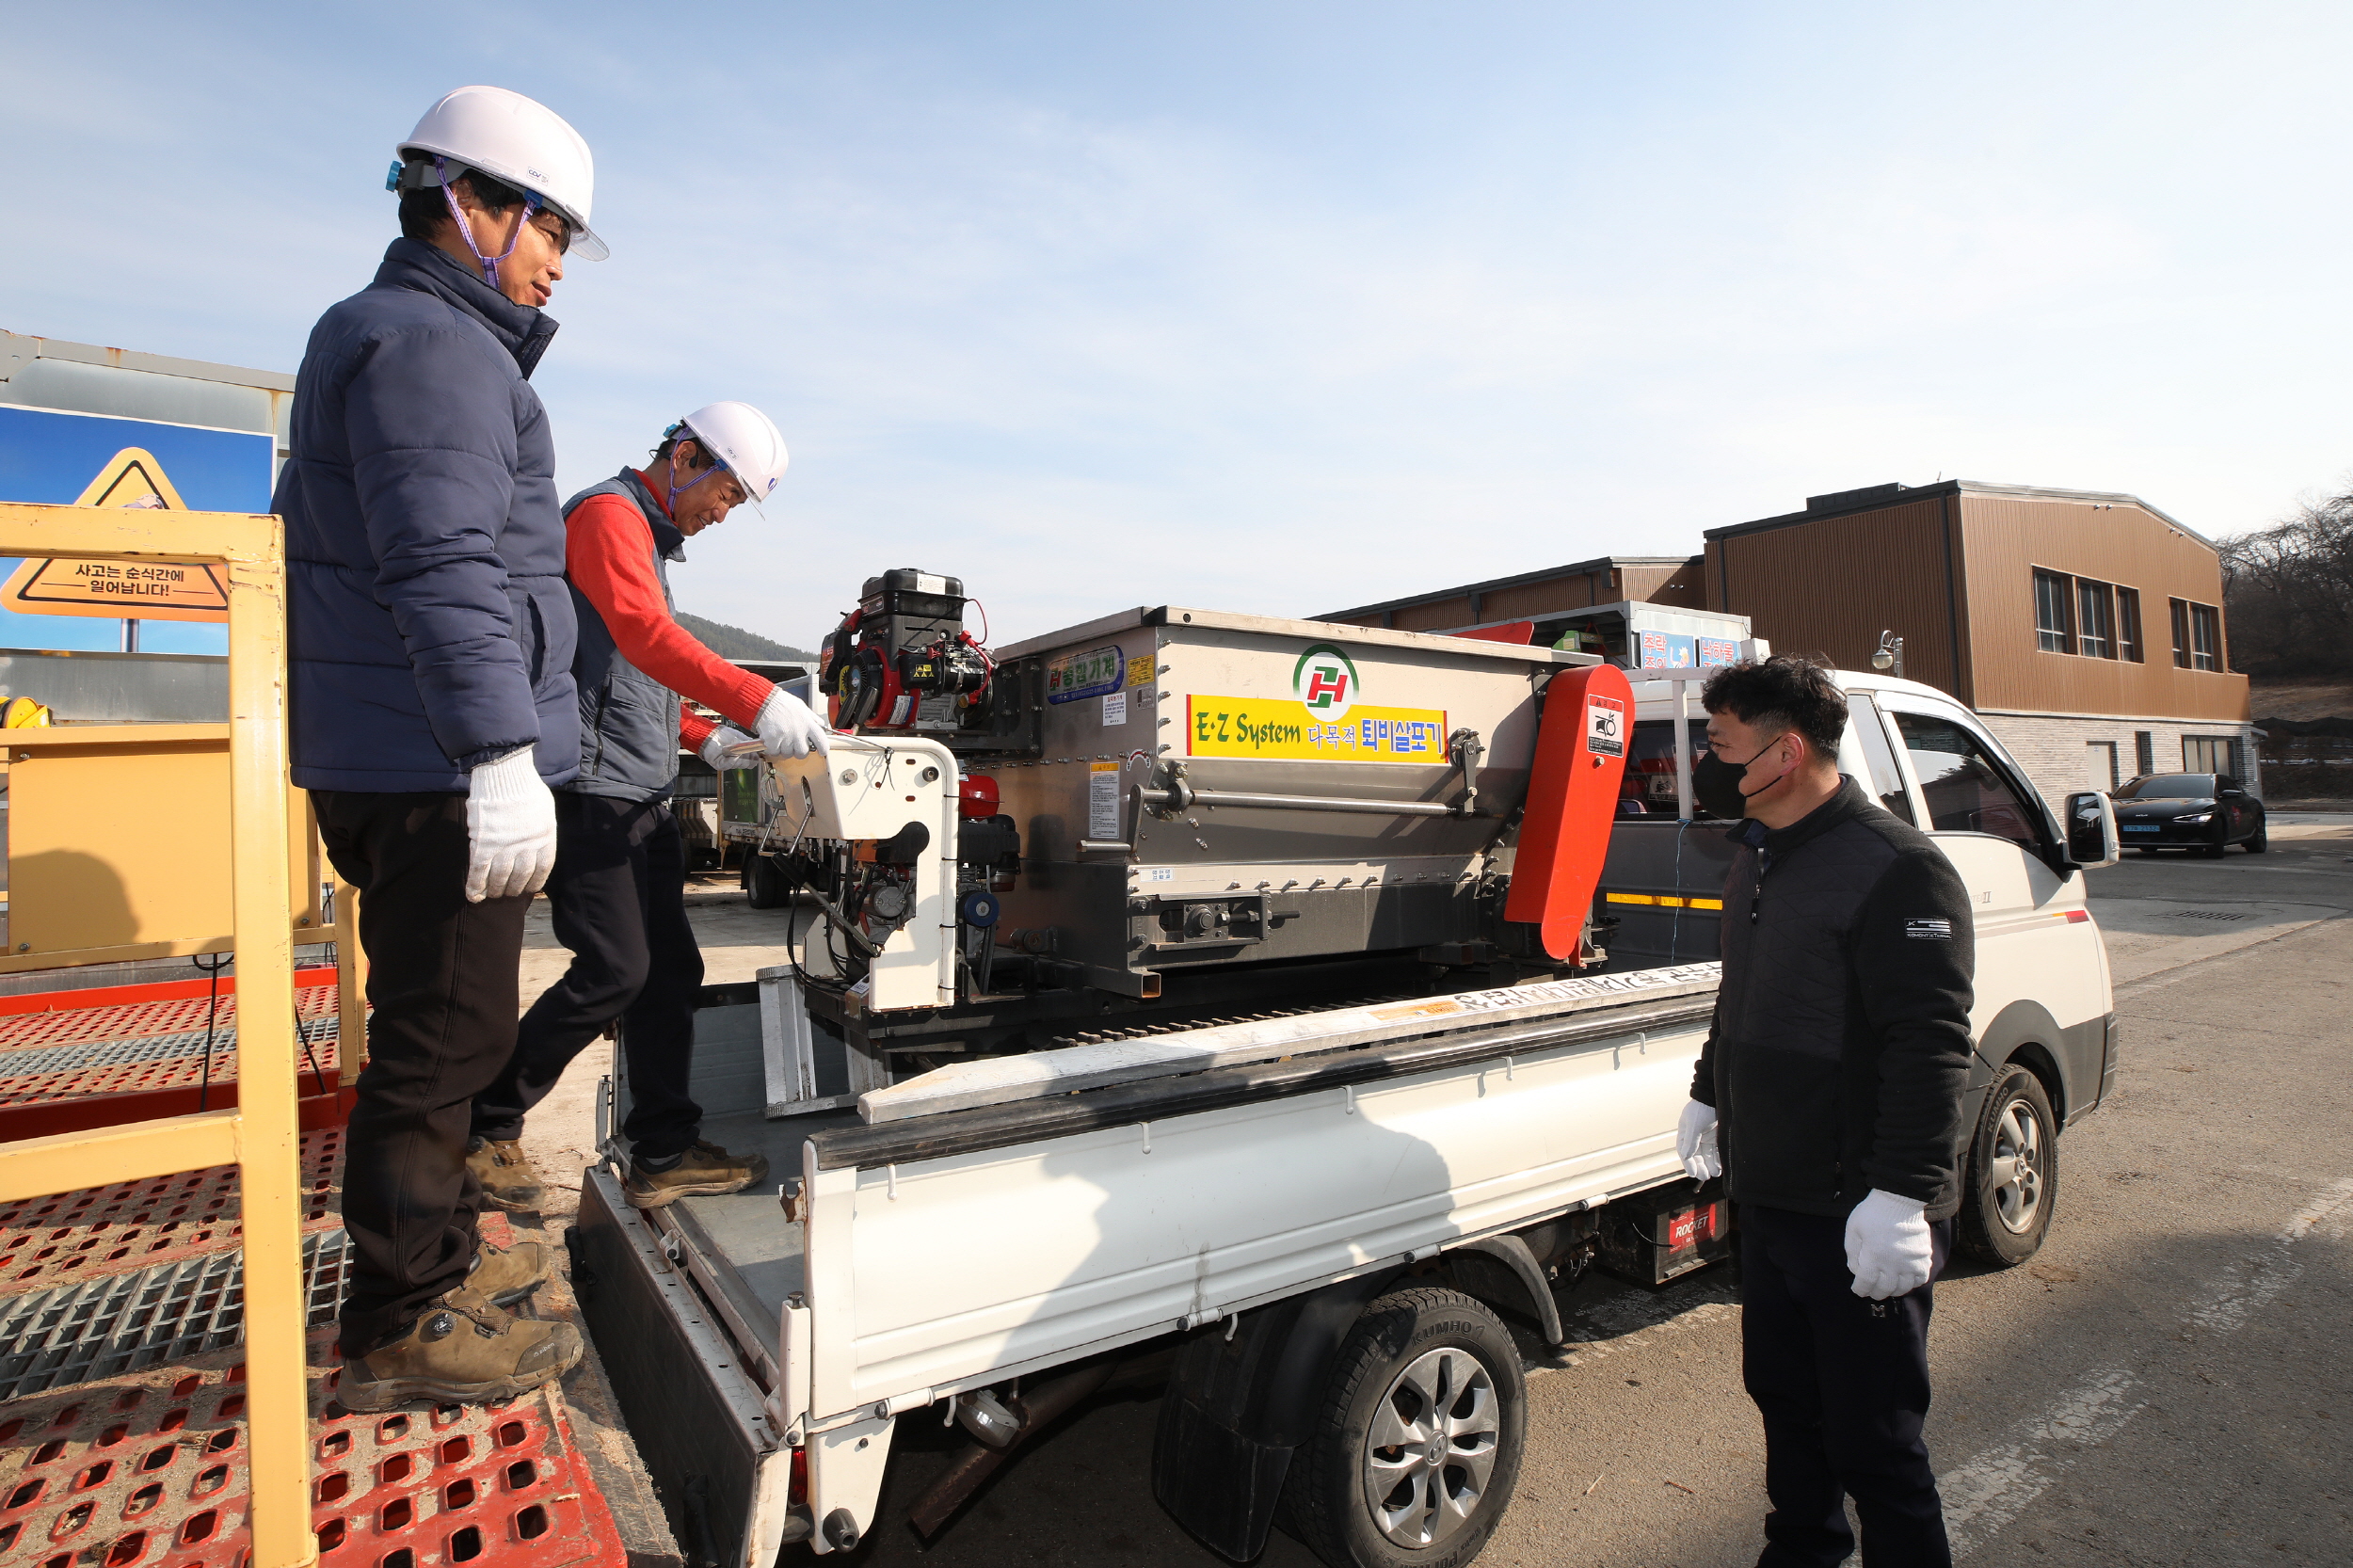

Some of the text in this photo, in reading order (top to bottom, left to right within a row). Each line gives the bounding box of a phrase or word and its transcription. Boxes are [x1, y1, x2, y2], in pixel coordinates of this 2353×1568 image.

[75, 564, 185, 583] 사고는 순식간에
[89, 580, 170, 598] 일어납니다!
[1643, 632, 1668, 656] 추락
[1702, 640, 1734, 663] 낙하물
[1236, 712, 1302, 751] System
[1306, 722, 1357, 751] 다목적
[1361, 718, 1443, 755] 퇴비살포기
[1987, 1086, 2009, 1133] KUMHO
[1675, 1215, 1709, 1239] ROCKET
[1411, 1320, 1472, 1348] KUMHO
